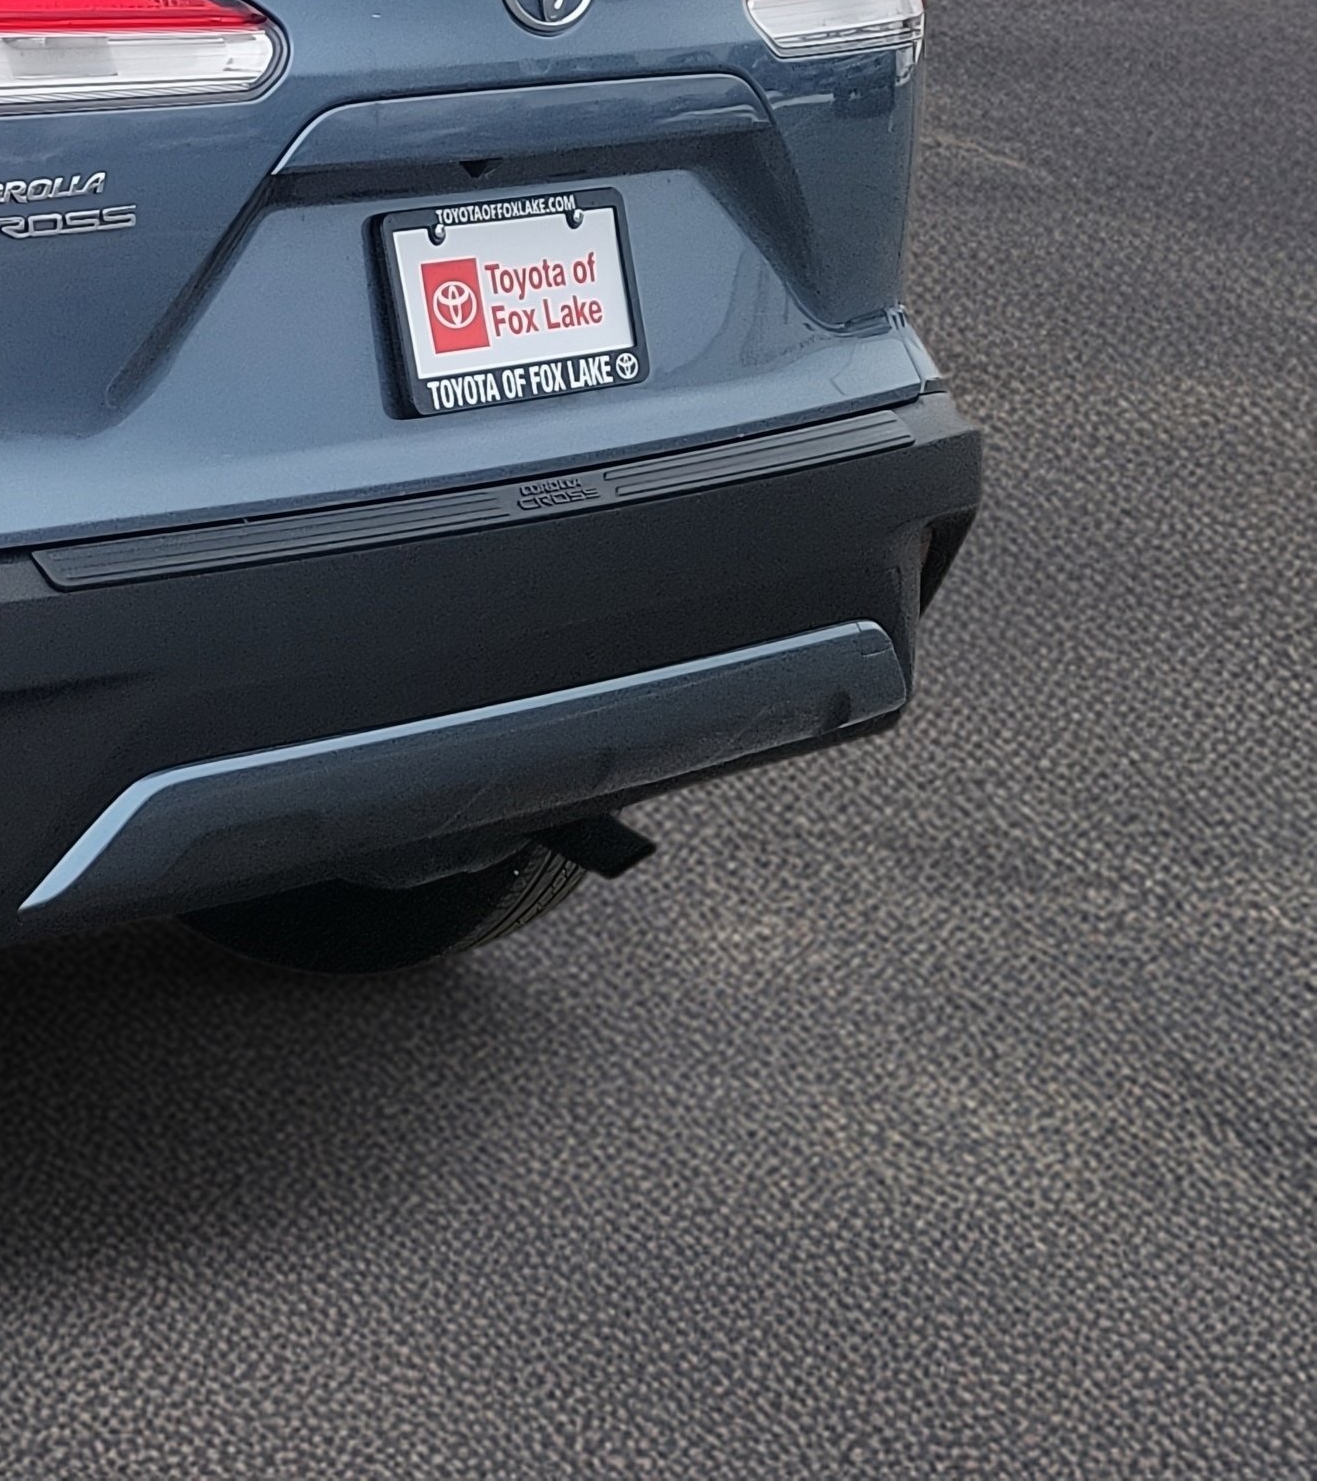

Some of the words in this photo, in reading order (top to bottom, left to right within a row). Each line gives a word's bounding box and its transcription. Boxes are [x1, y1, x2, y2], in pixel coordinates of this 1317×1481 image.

[435, 195, 577, 225] TOYOTAOFFOXLAKE.COM
[484, 259, 567, 300] Toyota
[573, 251, 597, 284] of
[490, 305, 540, 337] Fox
[542, 295, 604, 331] Lake
[427, 375, 501, 410] TOYOTA
[502, 369, 527, 398] OF
[529, 363, 565, 395] FOX
[568, 355, 614, 388] LAKE
[518, 487, 601, 510] CROSS
